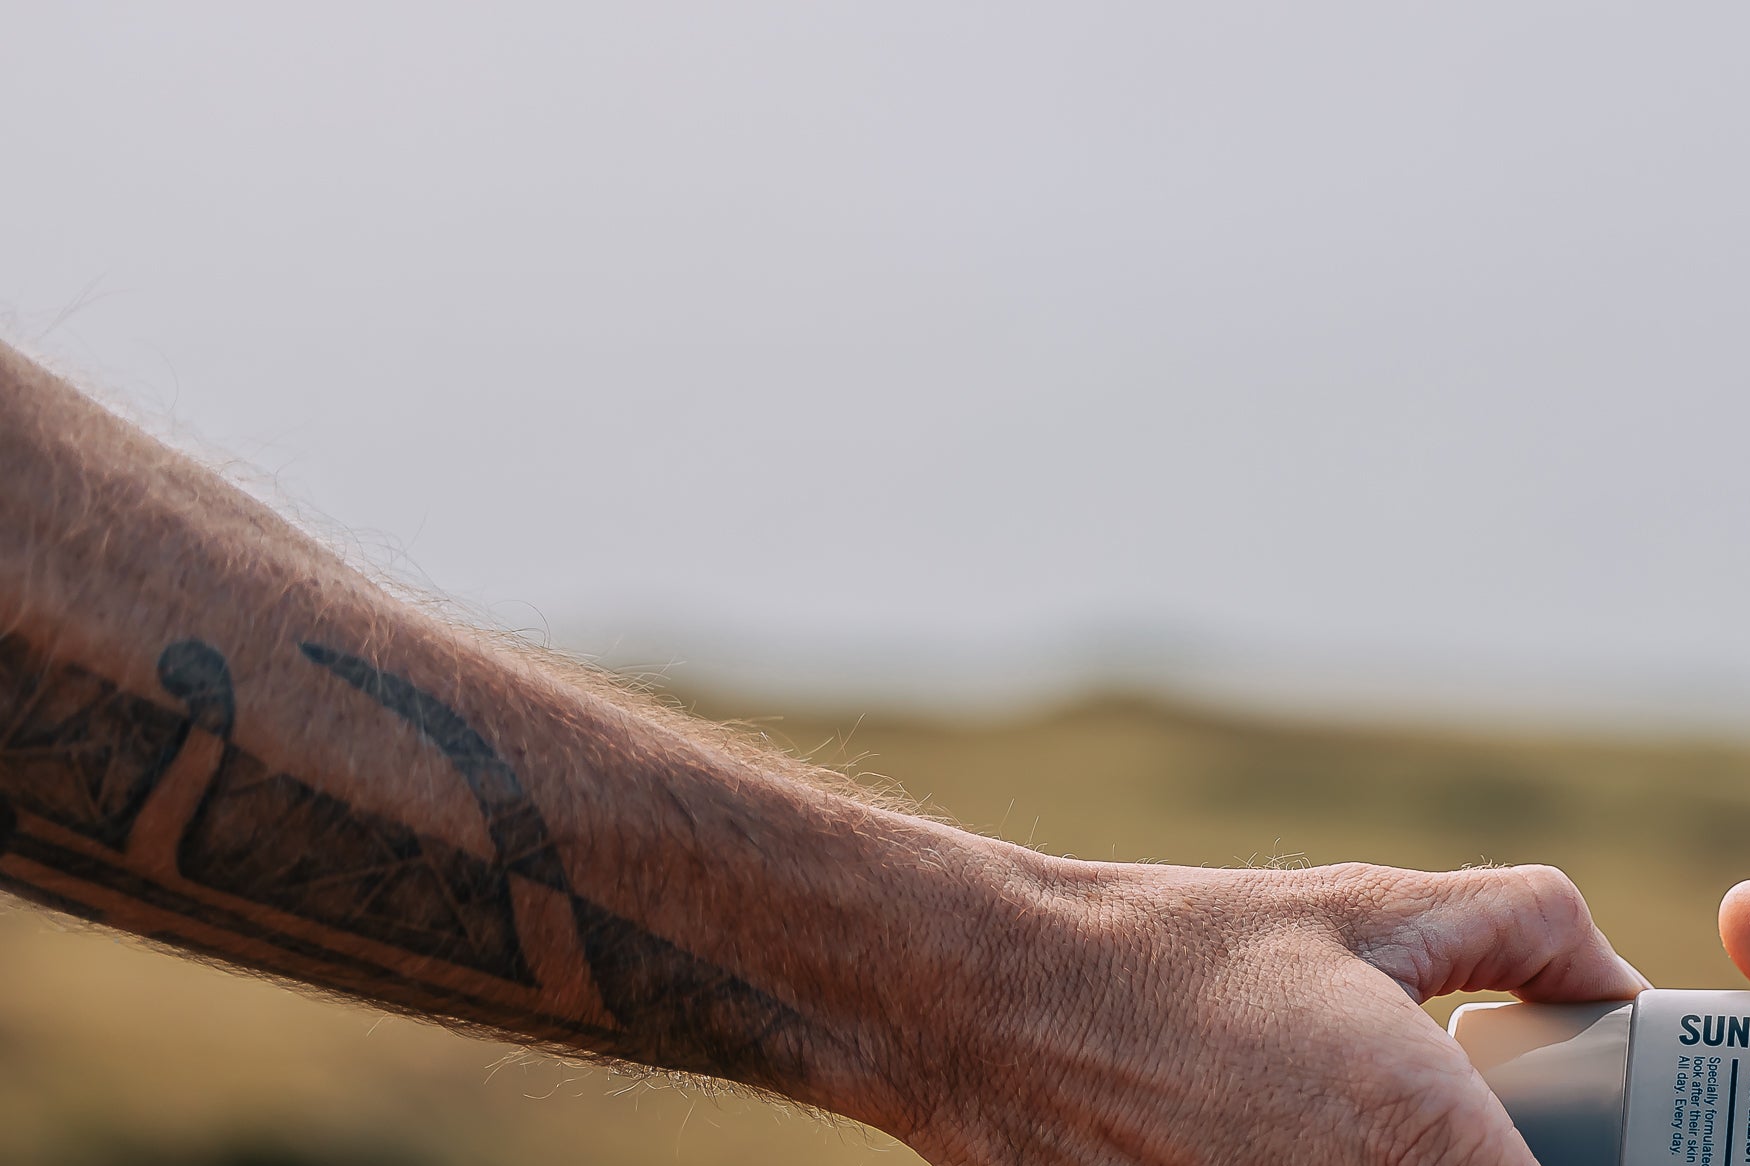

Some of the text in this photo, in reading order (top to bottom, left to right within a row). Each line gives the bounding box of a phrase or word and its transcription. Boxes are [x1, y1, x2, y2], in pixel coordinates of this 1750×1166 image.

[1679, 1014, 1750, 1049] SUN
[1693, 1056, 1705, 1078] look
[1691, 1081, 1703, 1107] after
[1704, 1056, 1721, 1106] Specially
[1669, 1055, 1690, 1155] All day. Every day.
[1689, 1110, 1701, 1136] their
[1686, 1140, 1698, 1163] skin
